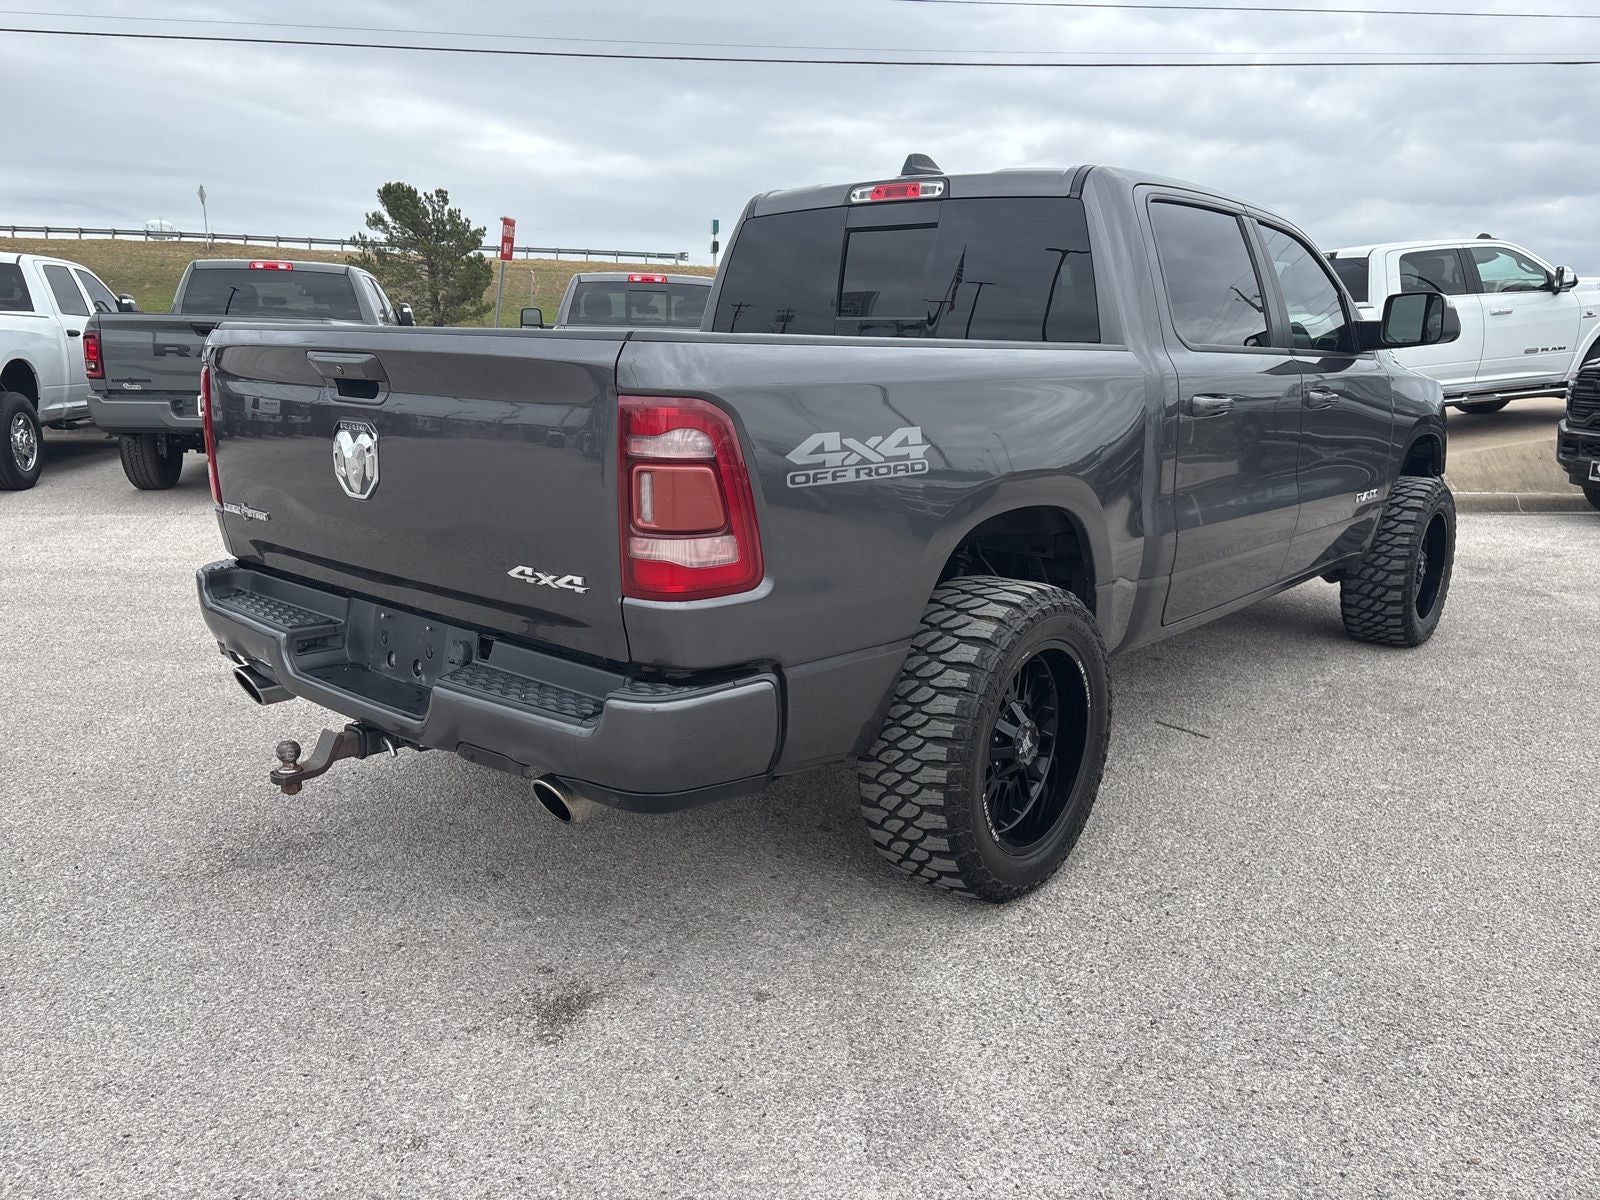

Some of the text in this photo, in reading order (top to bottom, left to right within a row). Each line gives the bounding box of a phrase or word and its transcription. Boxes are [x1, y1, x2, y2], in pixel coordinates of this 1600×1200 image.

[503, 242, 512, 255] WAY
[340, 422, 367, 431] RAM
[789, 461, 927, 486] OFF ROAD
[1355, 488, 1379, 504] RAM
